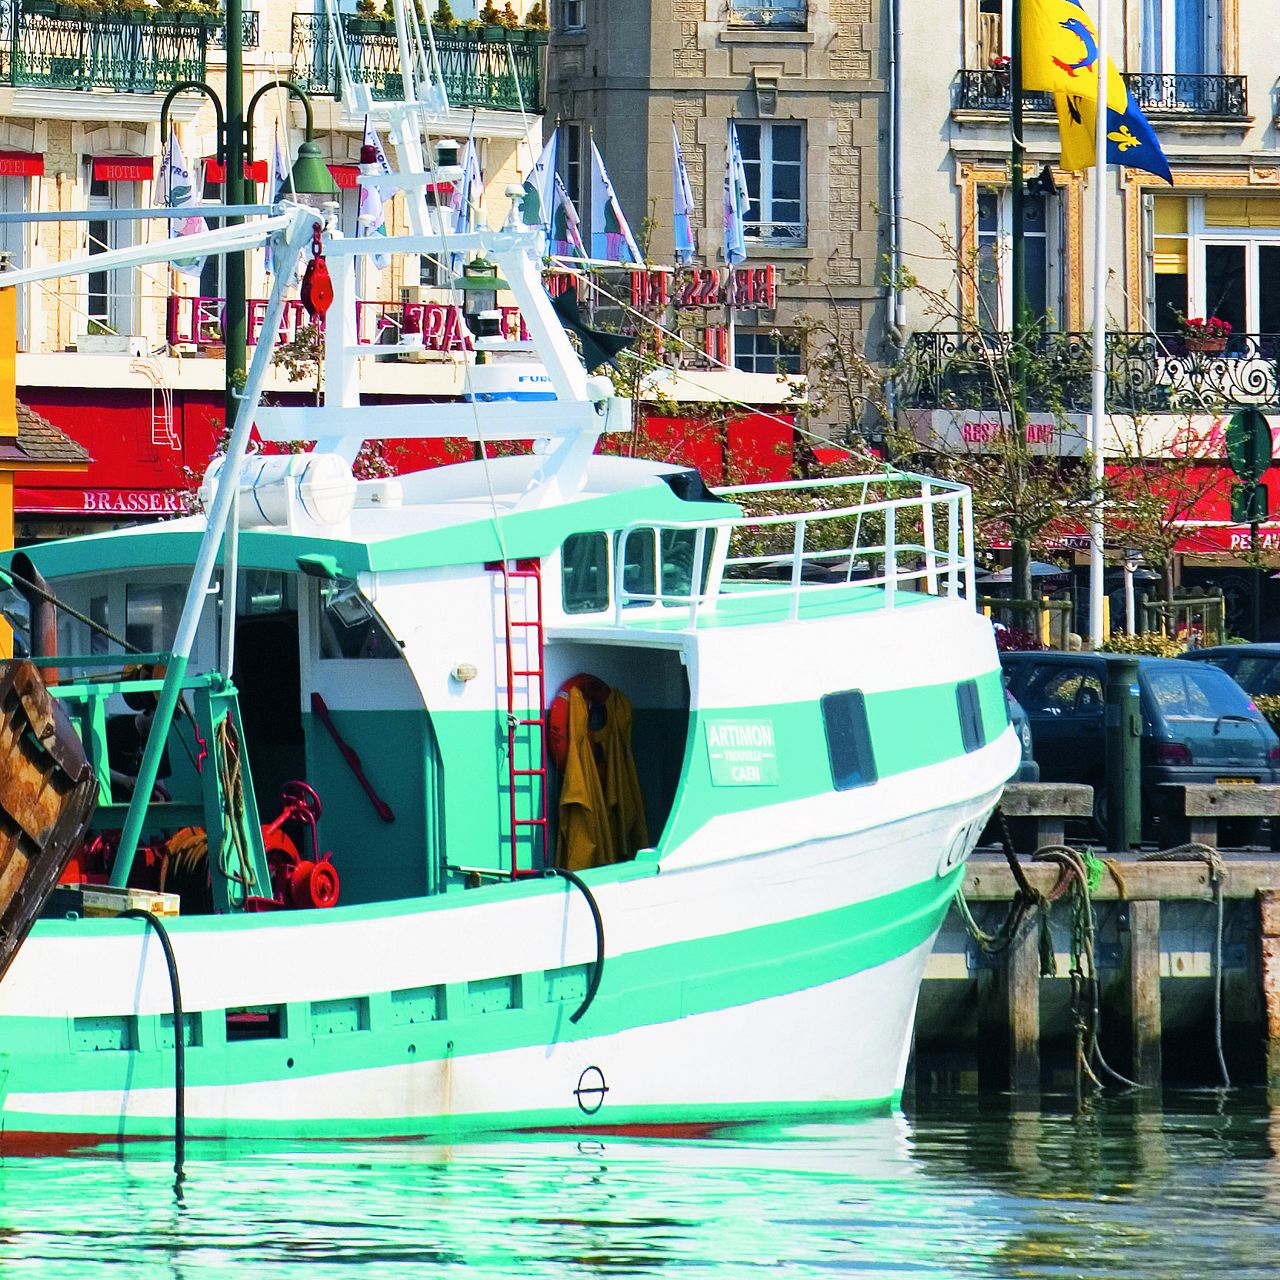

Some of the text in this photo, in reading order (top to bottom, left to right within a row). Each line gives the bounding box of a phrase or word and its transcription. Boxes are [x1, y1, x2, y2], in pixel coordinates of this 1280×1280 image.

[709, 725, 773, 747] ARTIMON
[723, 750, 763, 762] TROUVILLE
[731, 766, 761, 782] CAEN
